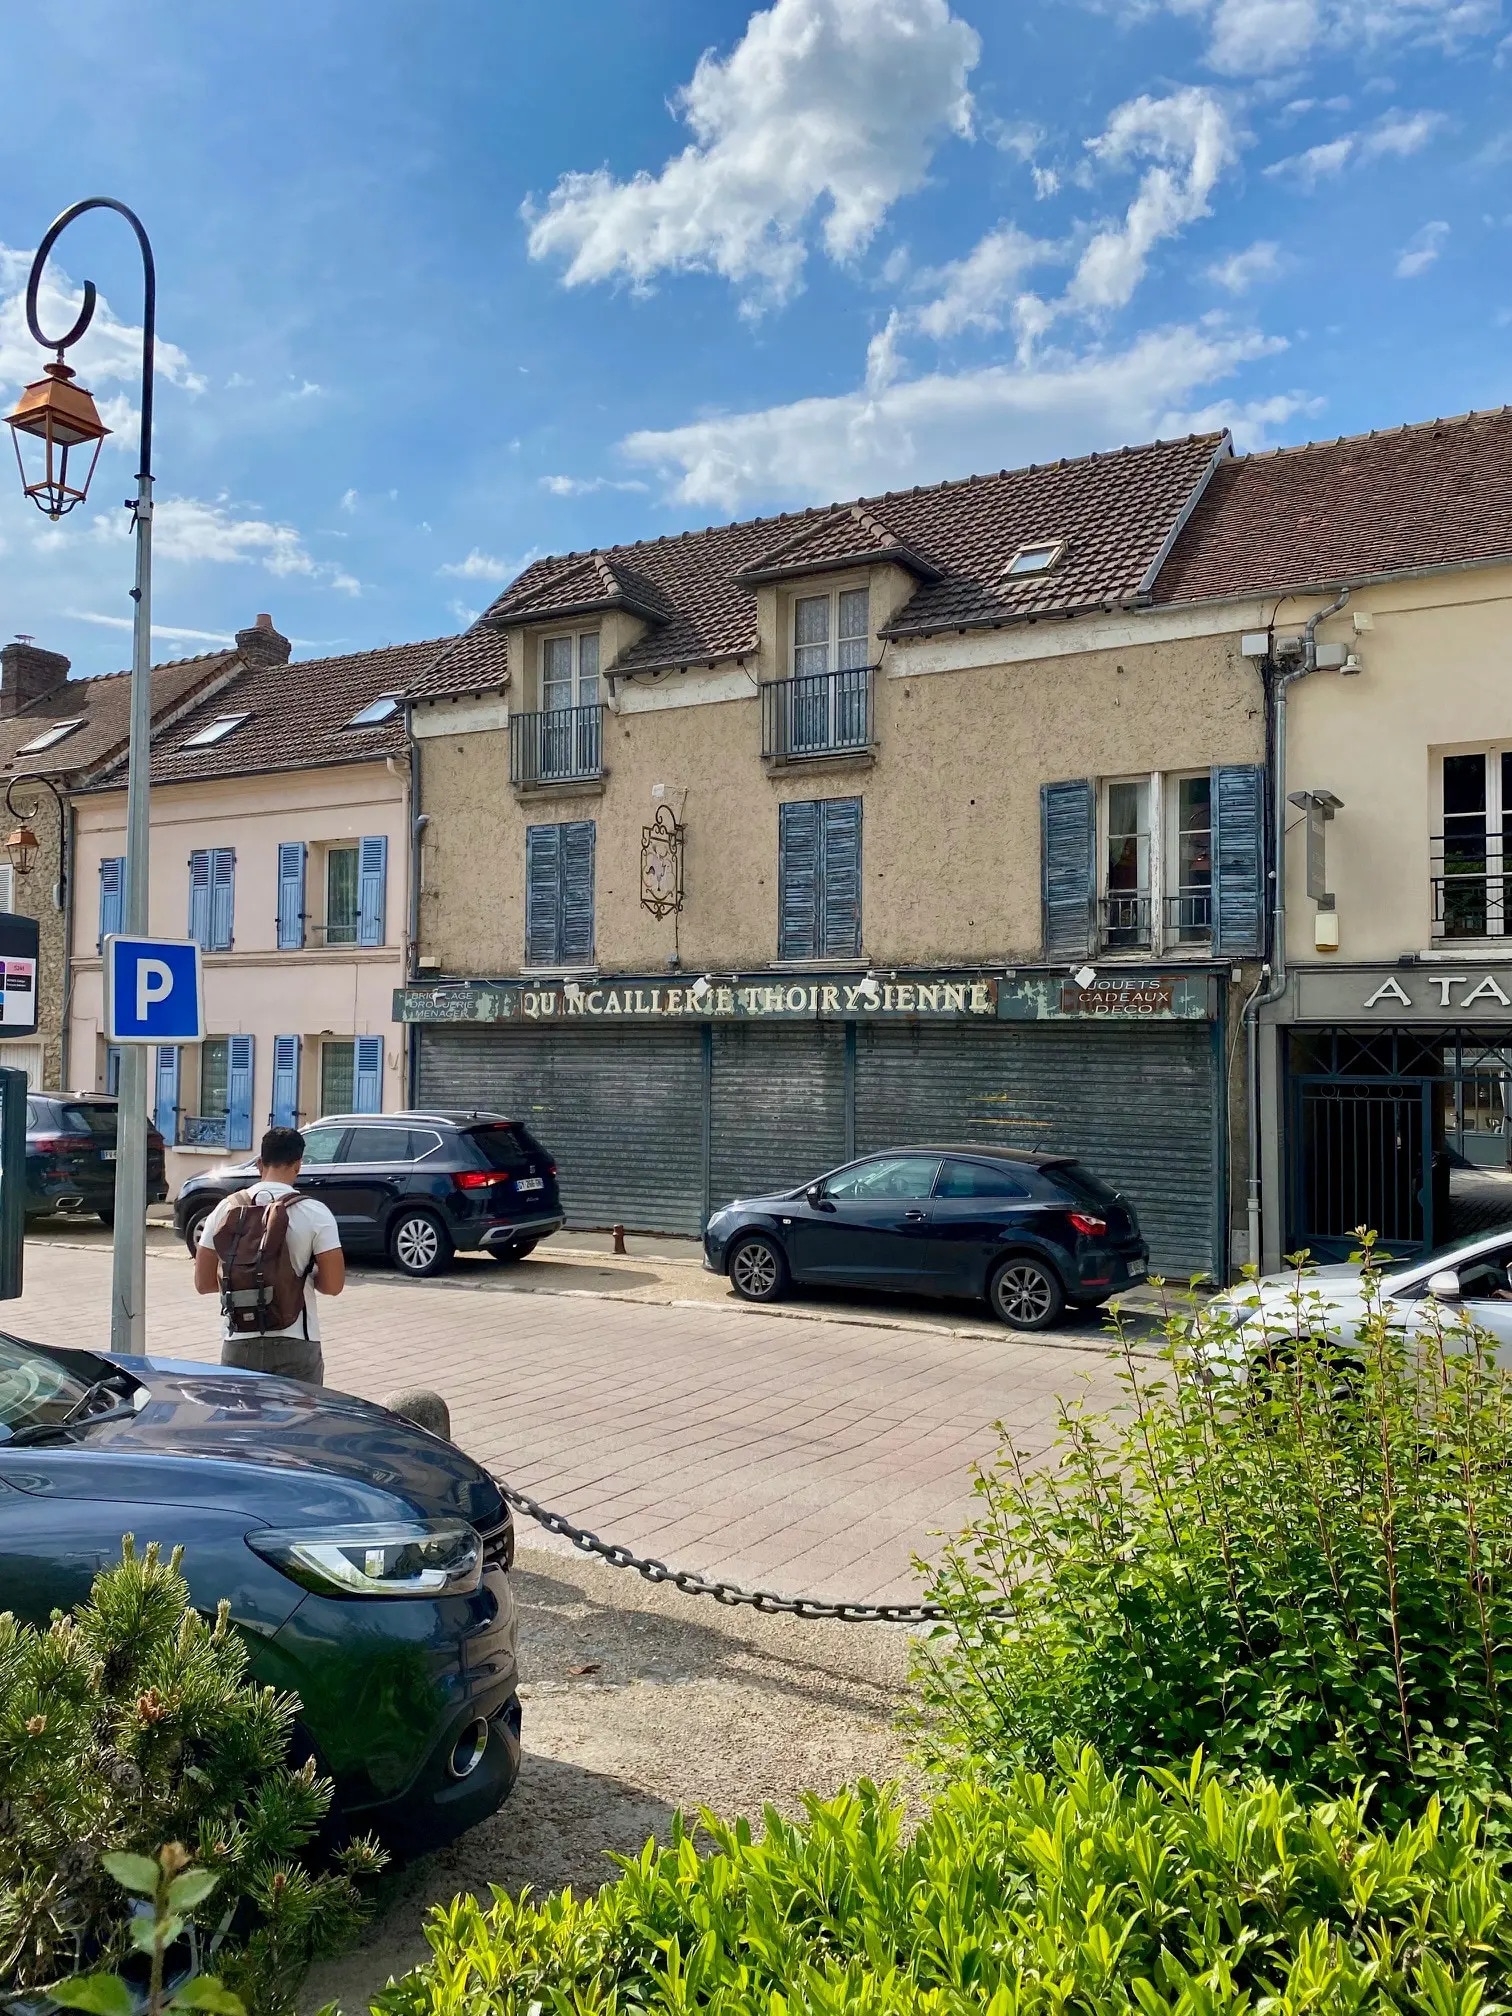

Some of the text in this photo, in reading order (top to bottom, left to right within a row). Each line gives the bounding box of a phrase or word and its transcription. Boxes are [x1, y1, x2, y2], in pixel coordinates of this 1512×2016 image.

[136, 958, 174, 1021] P
[1087, 980, 1161, 990] JOUETS
[1363, 976, 1412, 1007] A
[744, 984, 991, 1014] THOIRYSIENNE
[1078, 992, 1170, 1002] CADEAUX
[1094, 1004, 1153, 1014] DECO
